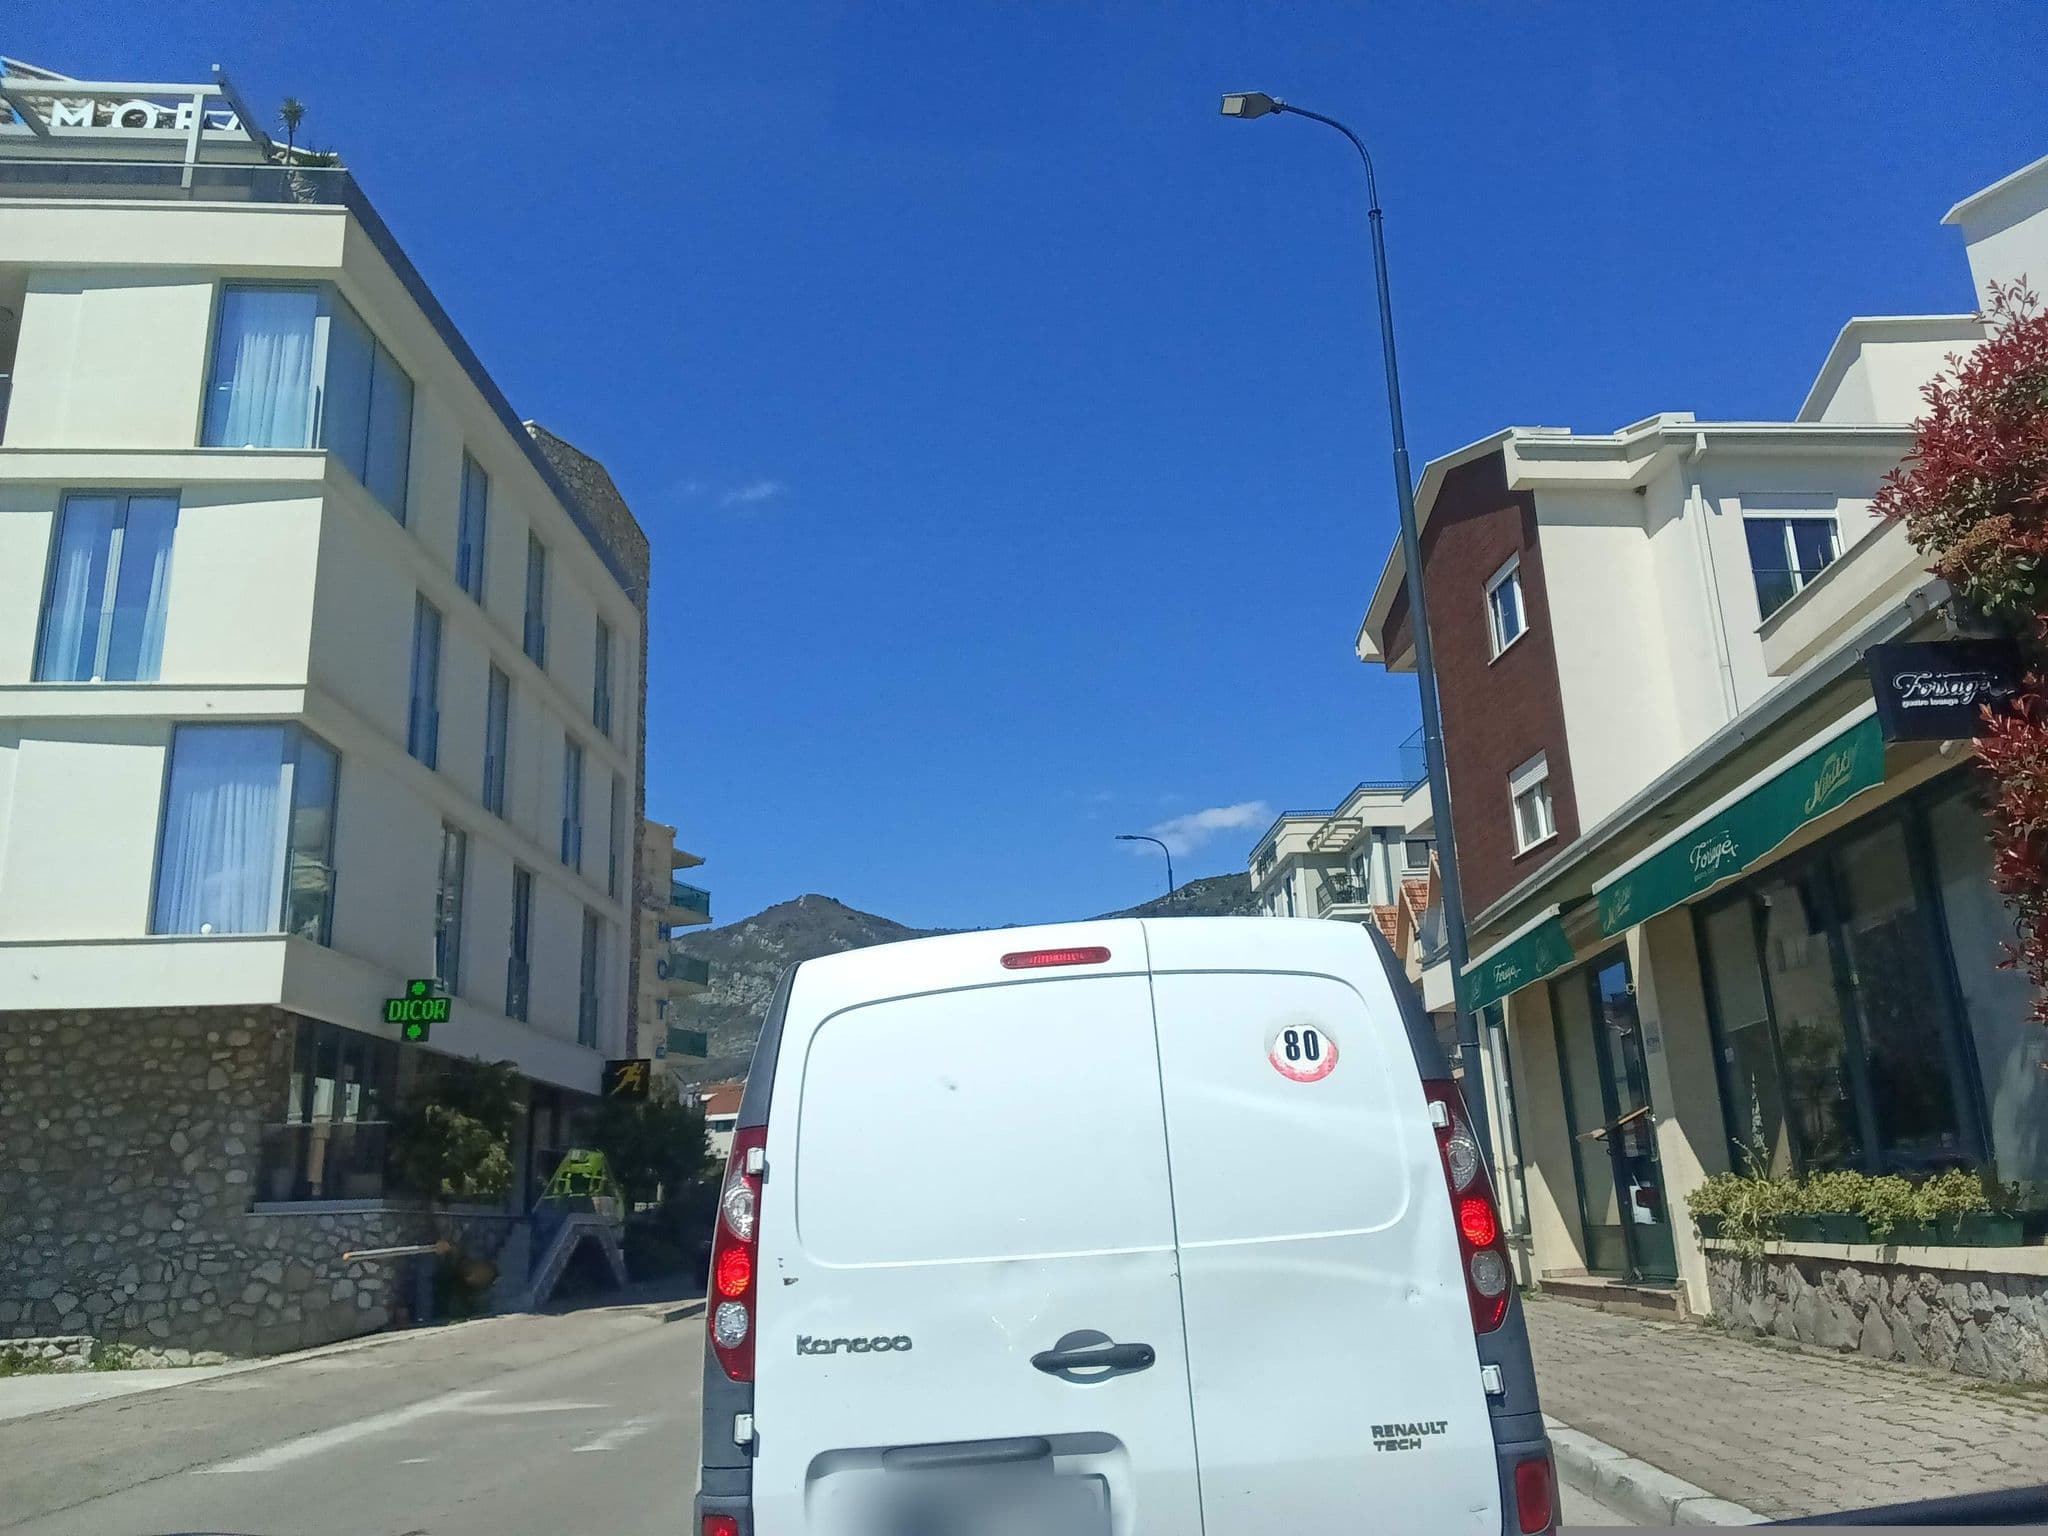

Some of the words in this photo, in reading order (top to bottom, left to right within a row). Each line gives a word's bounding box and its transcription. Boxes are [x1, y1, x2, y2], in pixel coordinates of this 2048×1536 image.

[388, 999, 447, 1021] DICOR
[1284, 1029, 1320, 1061] 80
[796, 1334, 913, 1356] Kangoo
[1370, 1420, 1449, 1439] RENAULT
[1373, 1438, 1422, 1452] TECH
